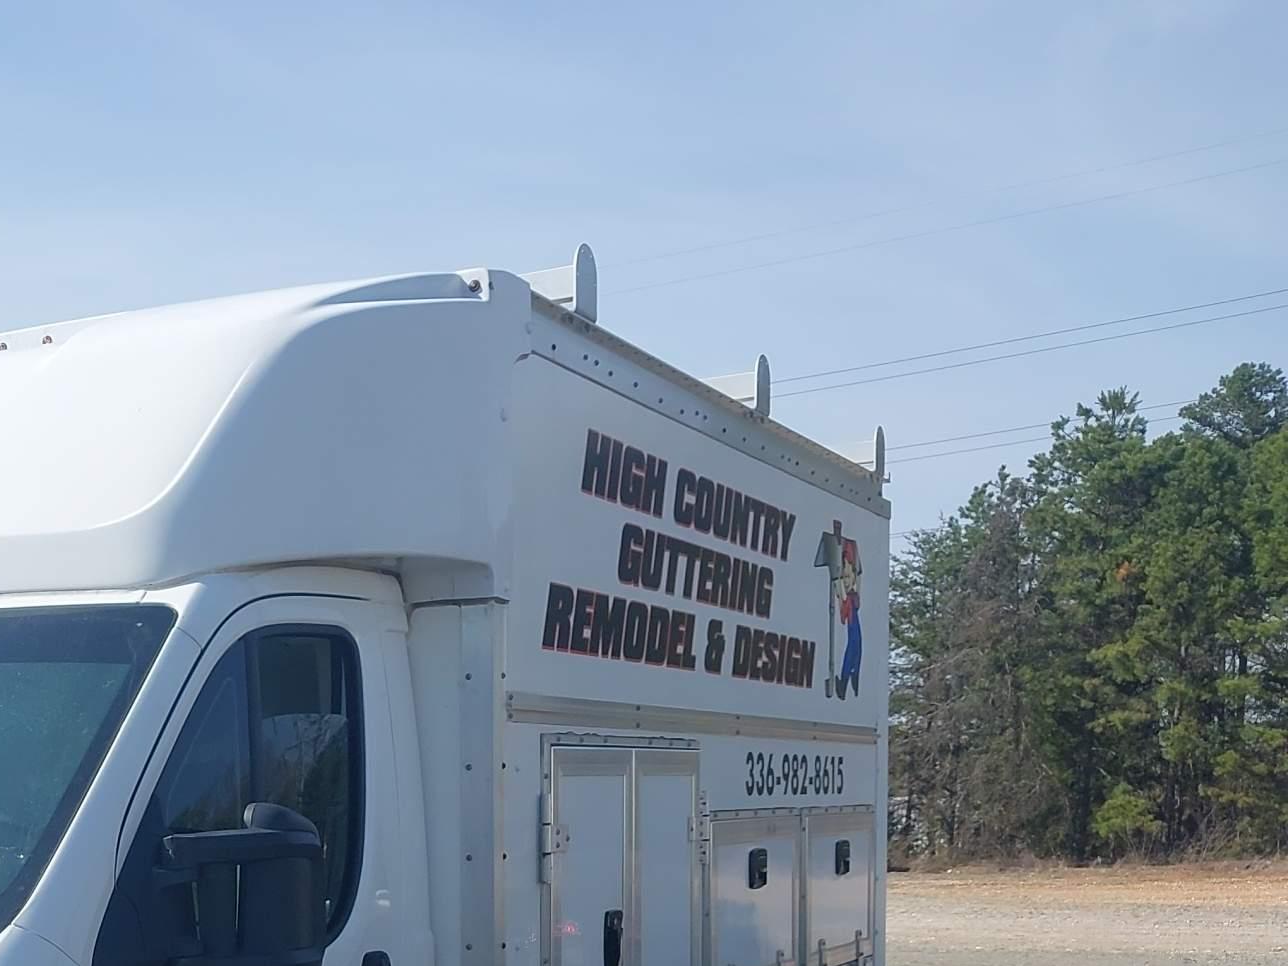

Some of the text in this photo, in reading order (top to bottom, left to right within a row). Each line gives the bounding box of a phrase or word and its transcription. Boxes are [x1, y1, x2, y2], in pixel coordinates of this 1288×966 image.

[581, 428, 796, 561] HIGH COUNTRY
[617, 522, 774, 619] GUTTERING
[542, 581, 816, 688] REMODEL & DESIGN
[745, 751, 844, 797] 336-982-8615
